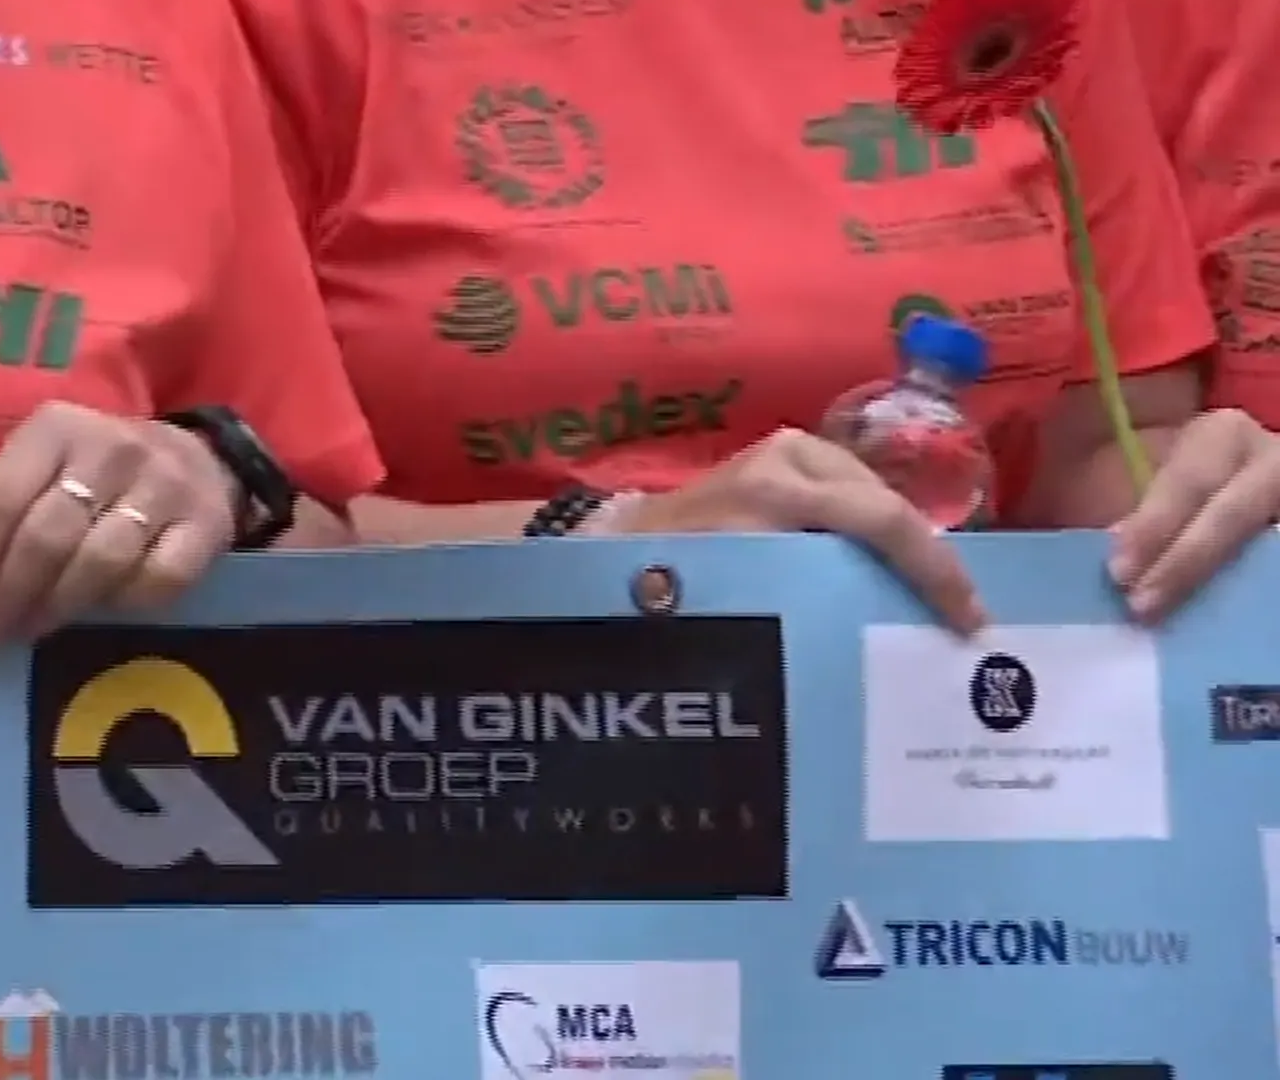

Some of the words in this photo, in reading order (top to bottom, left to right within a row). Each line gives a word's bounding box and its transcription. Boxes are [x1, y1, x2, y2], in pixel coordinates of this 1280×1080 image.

[267, 695, 438, 743] VAN
[459, 690, 763, 741] GINKEL
[268, 749, 539, 804] GROEP
[885, 918, 1070, 967] TRICON
[53, 1010, 380, 1079] WOLTERING
[556, 1003, 638, 1042] MCA
